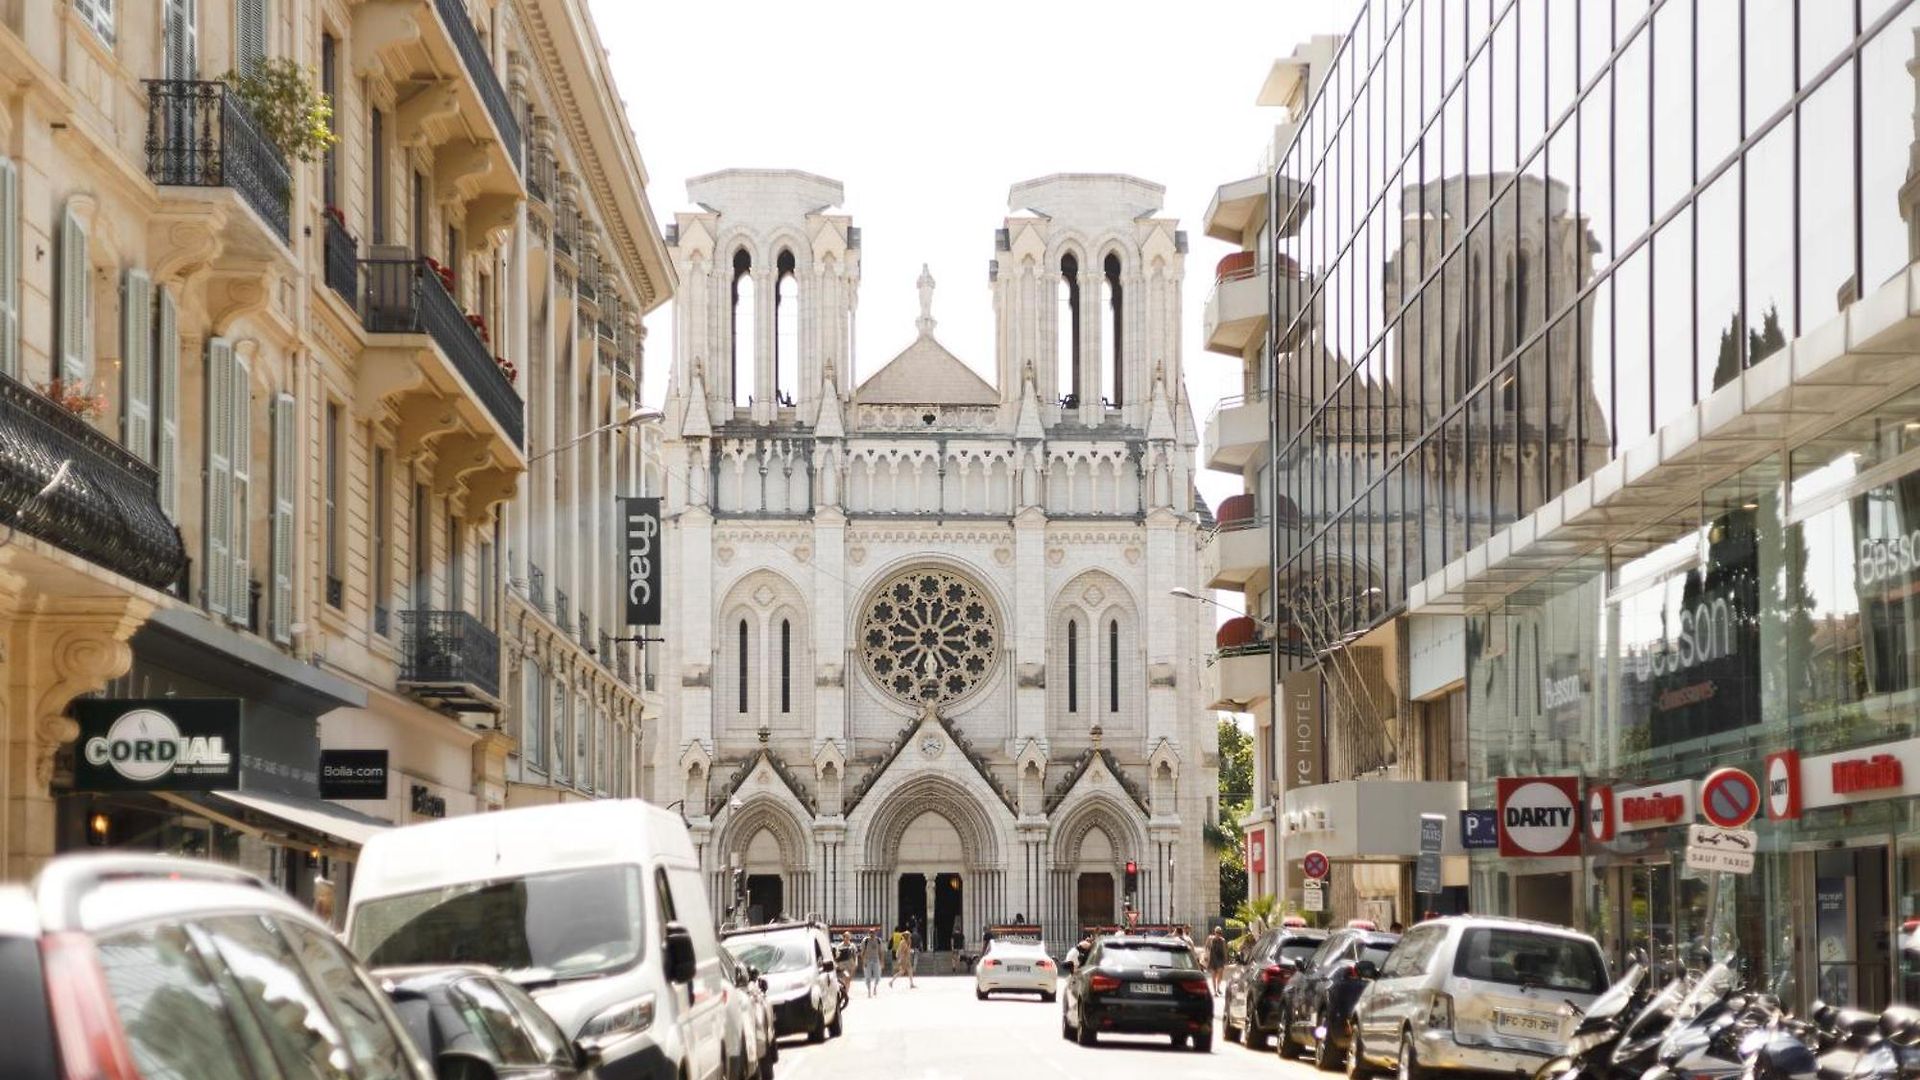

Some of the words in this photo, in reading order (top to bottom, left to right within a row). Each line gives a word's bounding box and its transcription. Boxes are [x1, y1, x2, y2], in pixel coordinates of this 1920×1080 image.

[629, 513, 658, 605] fnac
[1297, 688, 1312, 752] HOTEL
[84, 736, 230, 766] CORDIAL
[1467, 817, 1479, 836] P
[1506, 807, 1572, 827] DARTY
